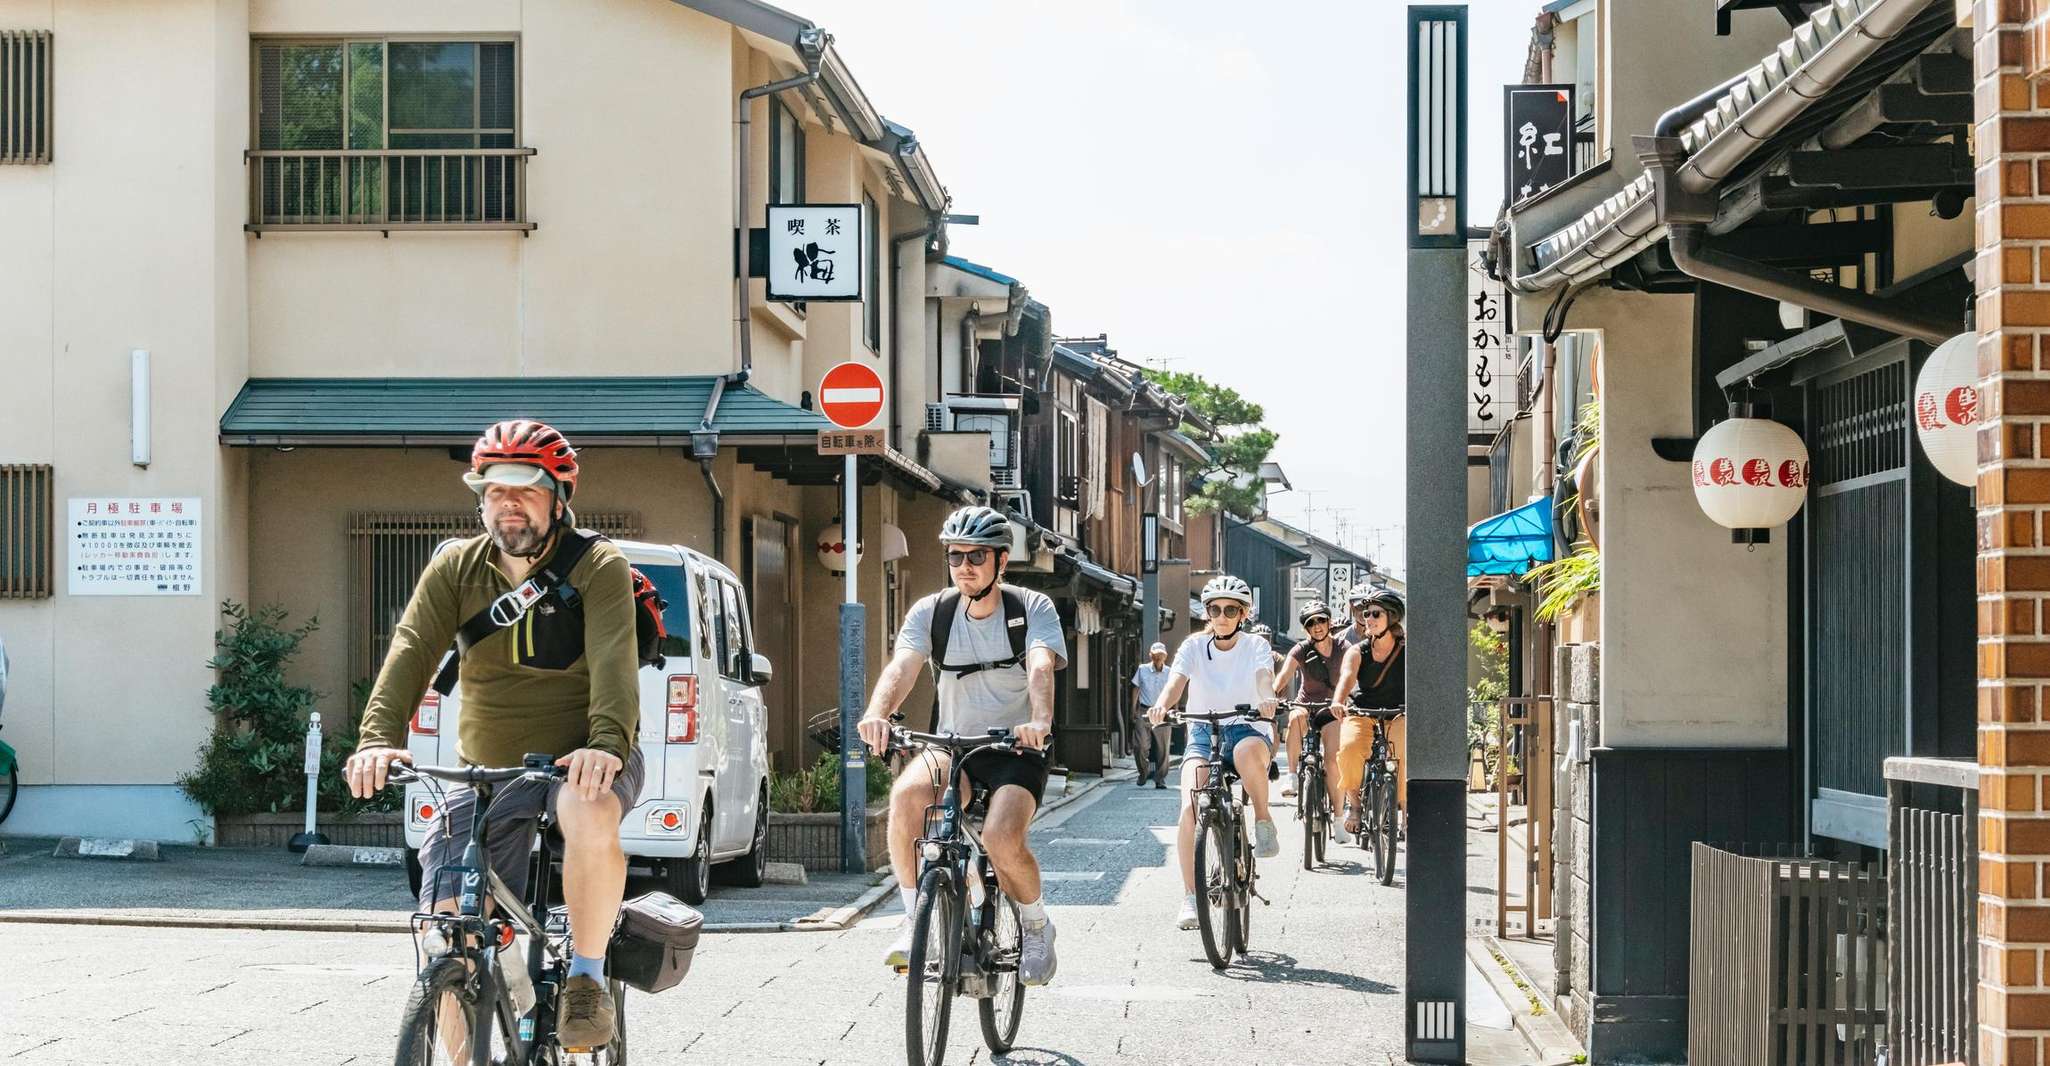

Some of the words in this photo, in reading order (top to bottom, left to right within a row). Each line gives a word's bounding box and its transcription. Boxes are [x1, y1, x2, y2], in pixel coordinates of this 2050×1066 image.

[787, 218, 841, 236] 喫茶
[793, 242, 836, 285] 梅
[1472, 290, 1501, 422] おかもと
[821, 434, 884, 449] 自転車を除く
[87, 502, 183, 514] 月極駐車場
